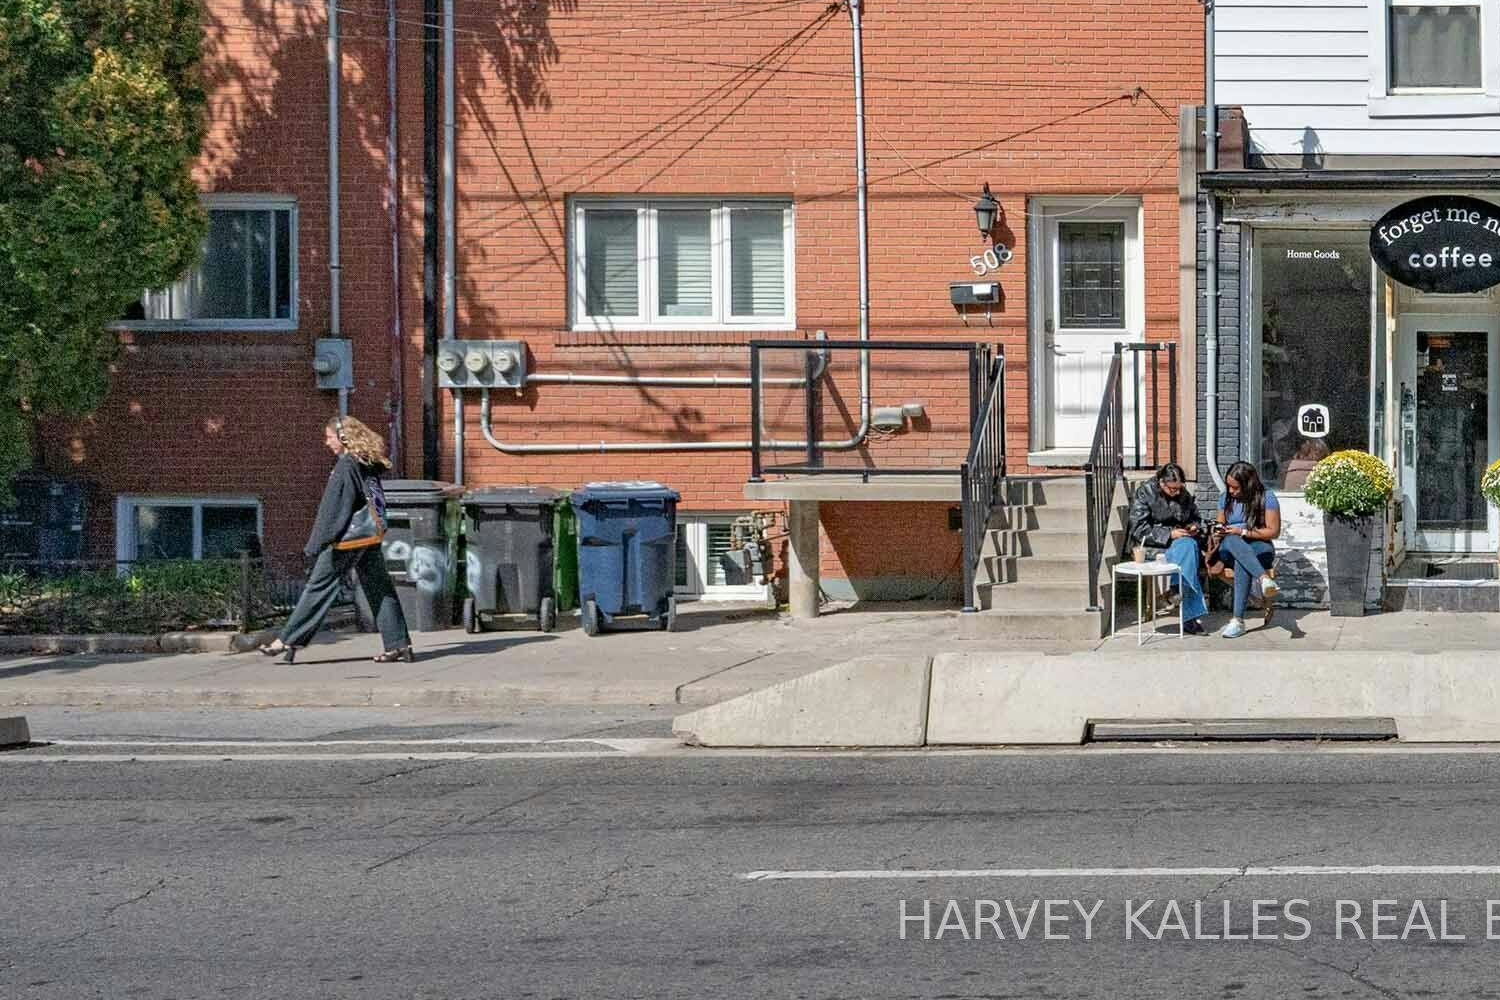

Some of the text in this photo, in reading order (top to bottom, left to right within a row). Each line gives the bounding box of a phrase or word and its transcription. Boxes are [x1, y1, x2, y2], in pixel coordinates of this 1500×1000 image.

[1378, 207, 1442, 246] forget
[1446, 207, 1481, 225] me
[970, 243, 1012, 276] 508
[1287, 249, 1340, 259] Home Goods
[1408, 246, 1493, 268] coffee
